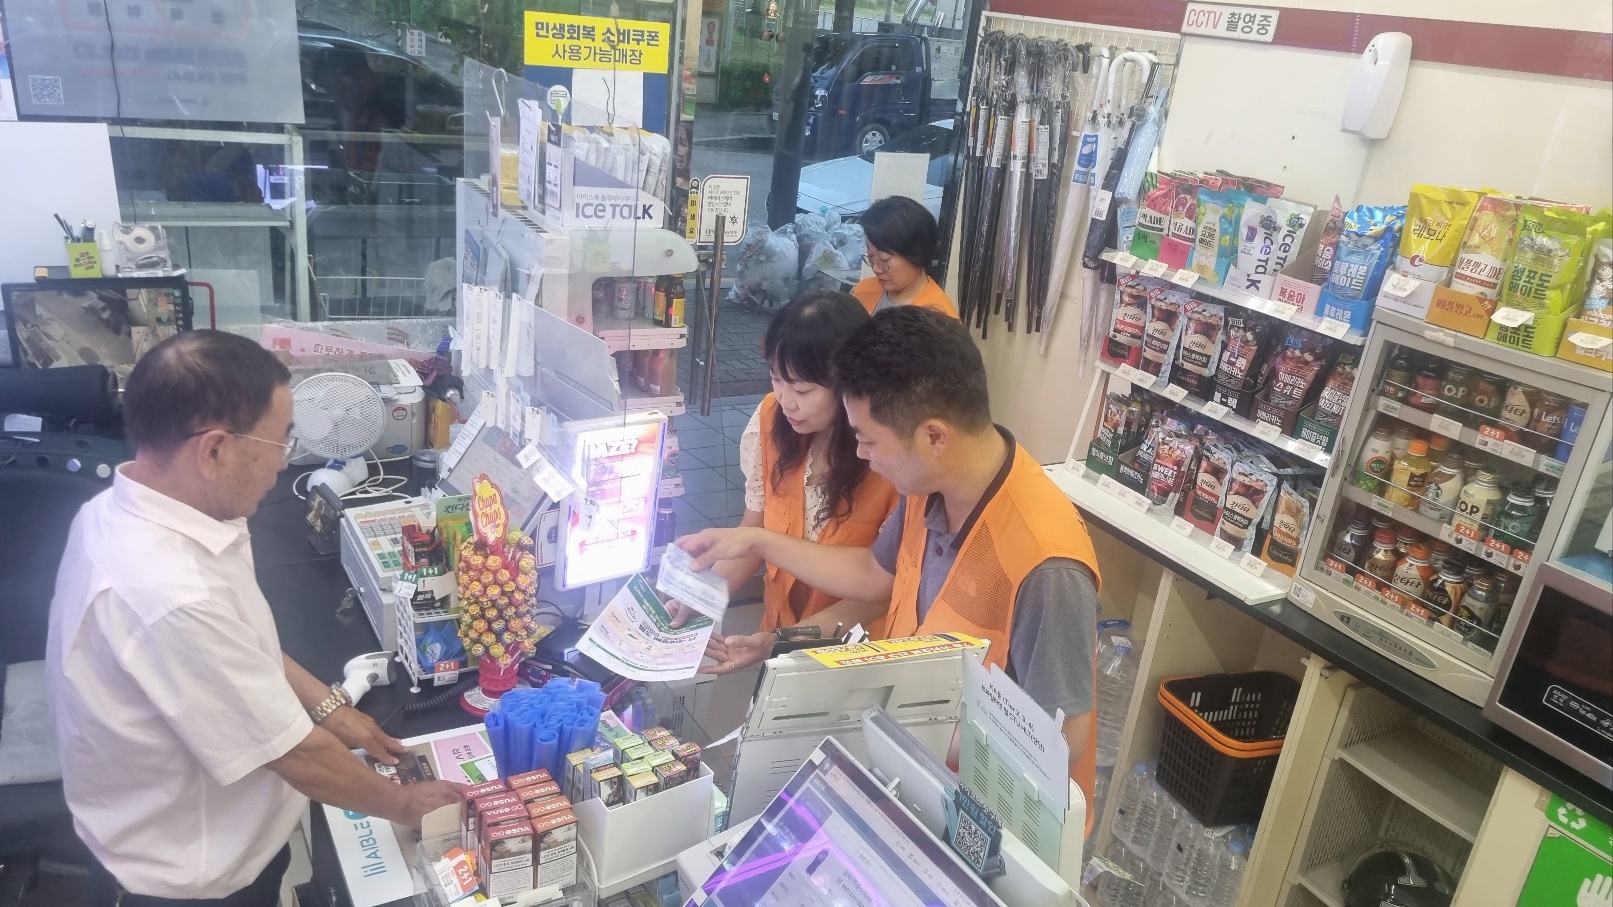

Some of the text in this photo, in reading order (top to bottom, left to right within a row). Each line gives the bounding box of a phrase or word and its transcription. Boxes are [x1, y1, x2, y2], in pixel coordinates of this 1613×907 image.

[1186, 8, 1273, 36] CCTV 촬영중
[535, 20, 660, 47] 민생회복 소비쿠폰
[551, 43, 643, 65] 사용가능매장
[688, 199, 697, 234] 미세요
[1412, 224, 1448, 244] 레모나
[1334, 259, 1368, 280] 블루레몬
[1511, 263, 1553, 289] 청포도
[1120, 275, 1132, 285] BIG
[1331, 273, 1366, 293] 에이드
[1150, 288, 1160, 299] BIG
[1279, 286, 1306, 305] 복숭아
[1508, 281, 1547, 300] 에이드
[1185, 301, 1197, 311] BIG
[1321, 302, 1352, 323] 블루레몬
[1436, 298, 1472, 318] 애플망고
[313, 343, 354, 356] 따뜻하게
[1496, 334, 1534, 350] 에이드
[1279, 371, 1307, 389] 아메리카노
[1273, 380, 1303, 399] 스위트
[1257, 409, 1282, 425] 아메리카노
[1484, 428, 1500, 439] 2+1
[1152, 463, 1177, 479] SWEET
[477, 493, 498, 511] Chupa
[481, 507, 501, 528] Chups
[1459, 525, 1475, 538] 2+1
[1489, 539, 1505, 552] 2+1
[1329, 560, 1342, 571] 2+1
[1518, 551, 1529, 562] 2+
[403, 572, 417, 582] 1+1
[422, 566, 438, 576] 1+1
[1358, 576, 1372, 588] 2+1
[1384, 590, 1398, 602] 2+1
[1411, 603, 1425, 615] 2+1
[439, 661, 454, 671] 2+1
[960, 792, 997, 836] 1만원 할인
[353, 820, 388, 878] lil AIBLE
[457, 865, 473, 886] 2+1
